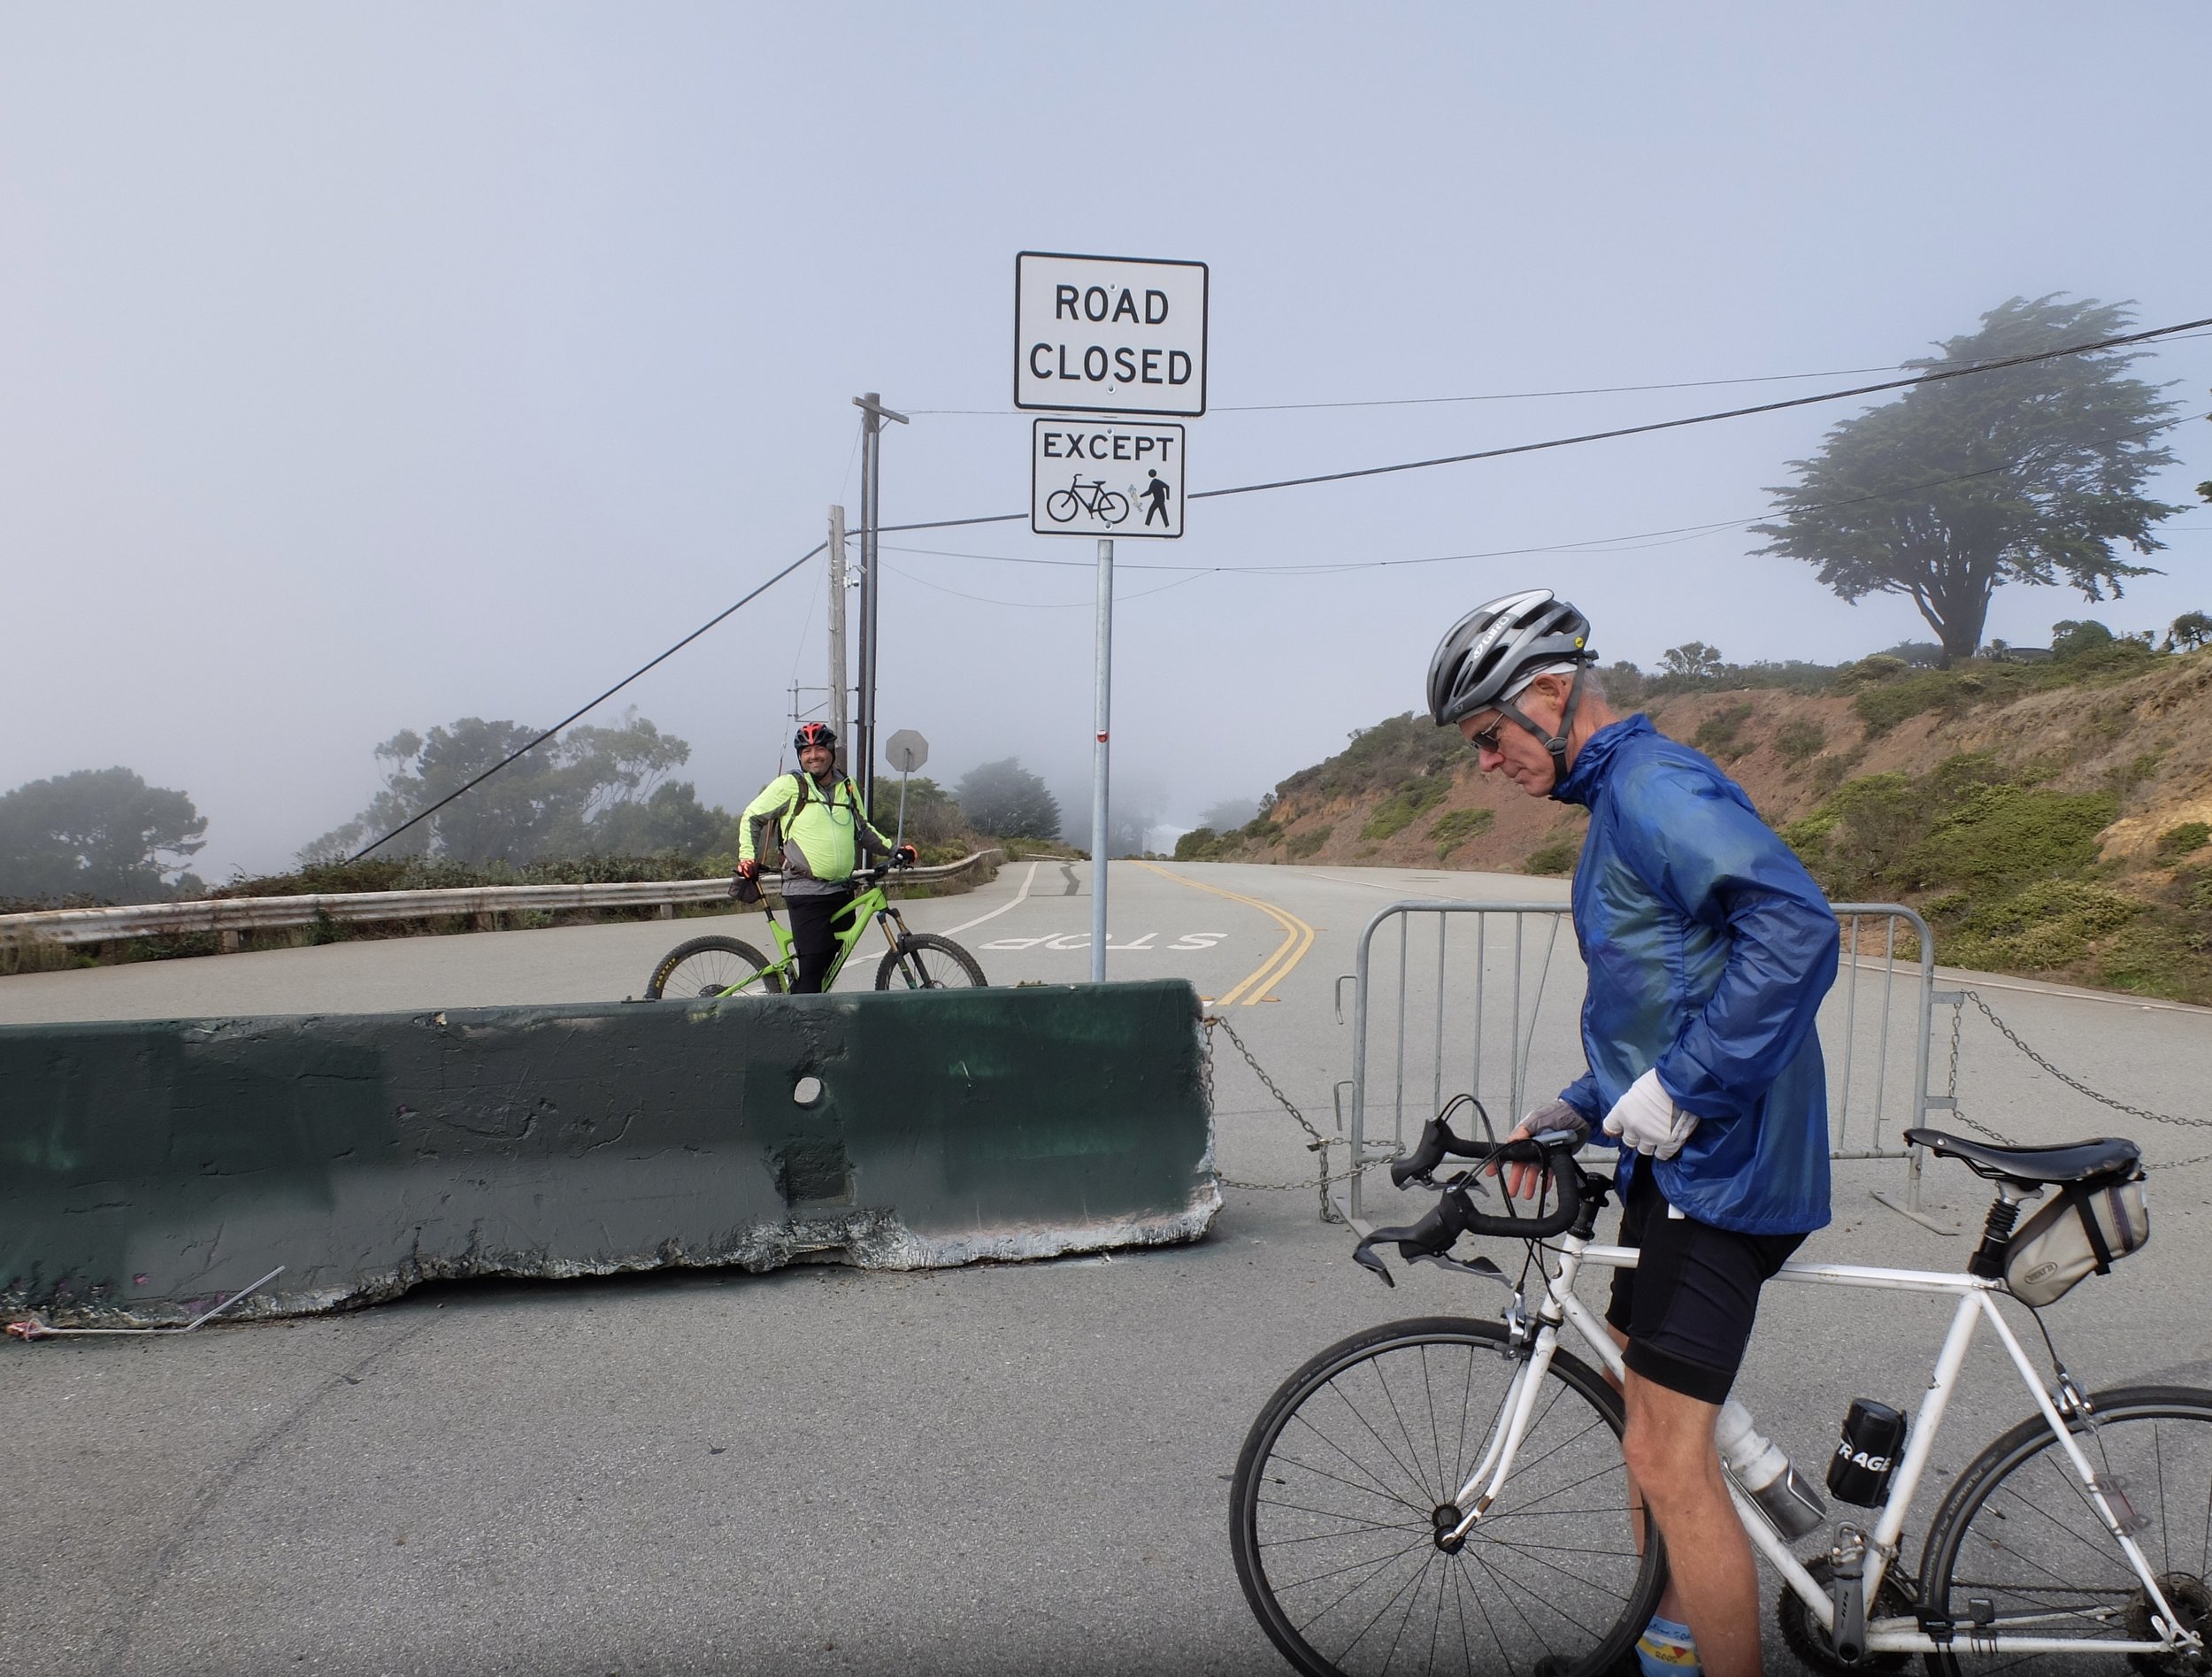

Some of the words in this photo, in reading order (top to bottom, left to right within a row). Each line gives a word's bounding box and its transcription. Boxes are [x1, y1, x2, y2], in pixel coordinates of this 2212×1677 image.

[1055, 283, 1169, 325] ROAD
[1029, 342, 1193, 386] CLOSED
[1043, 432, 1174, 462] EXCEPT
[1482, 616, 1509, 645] GIRO
[978, 932, 1229, 950] STOP
